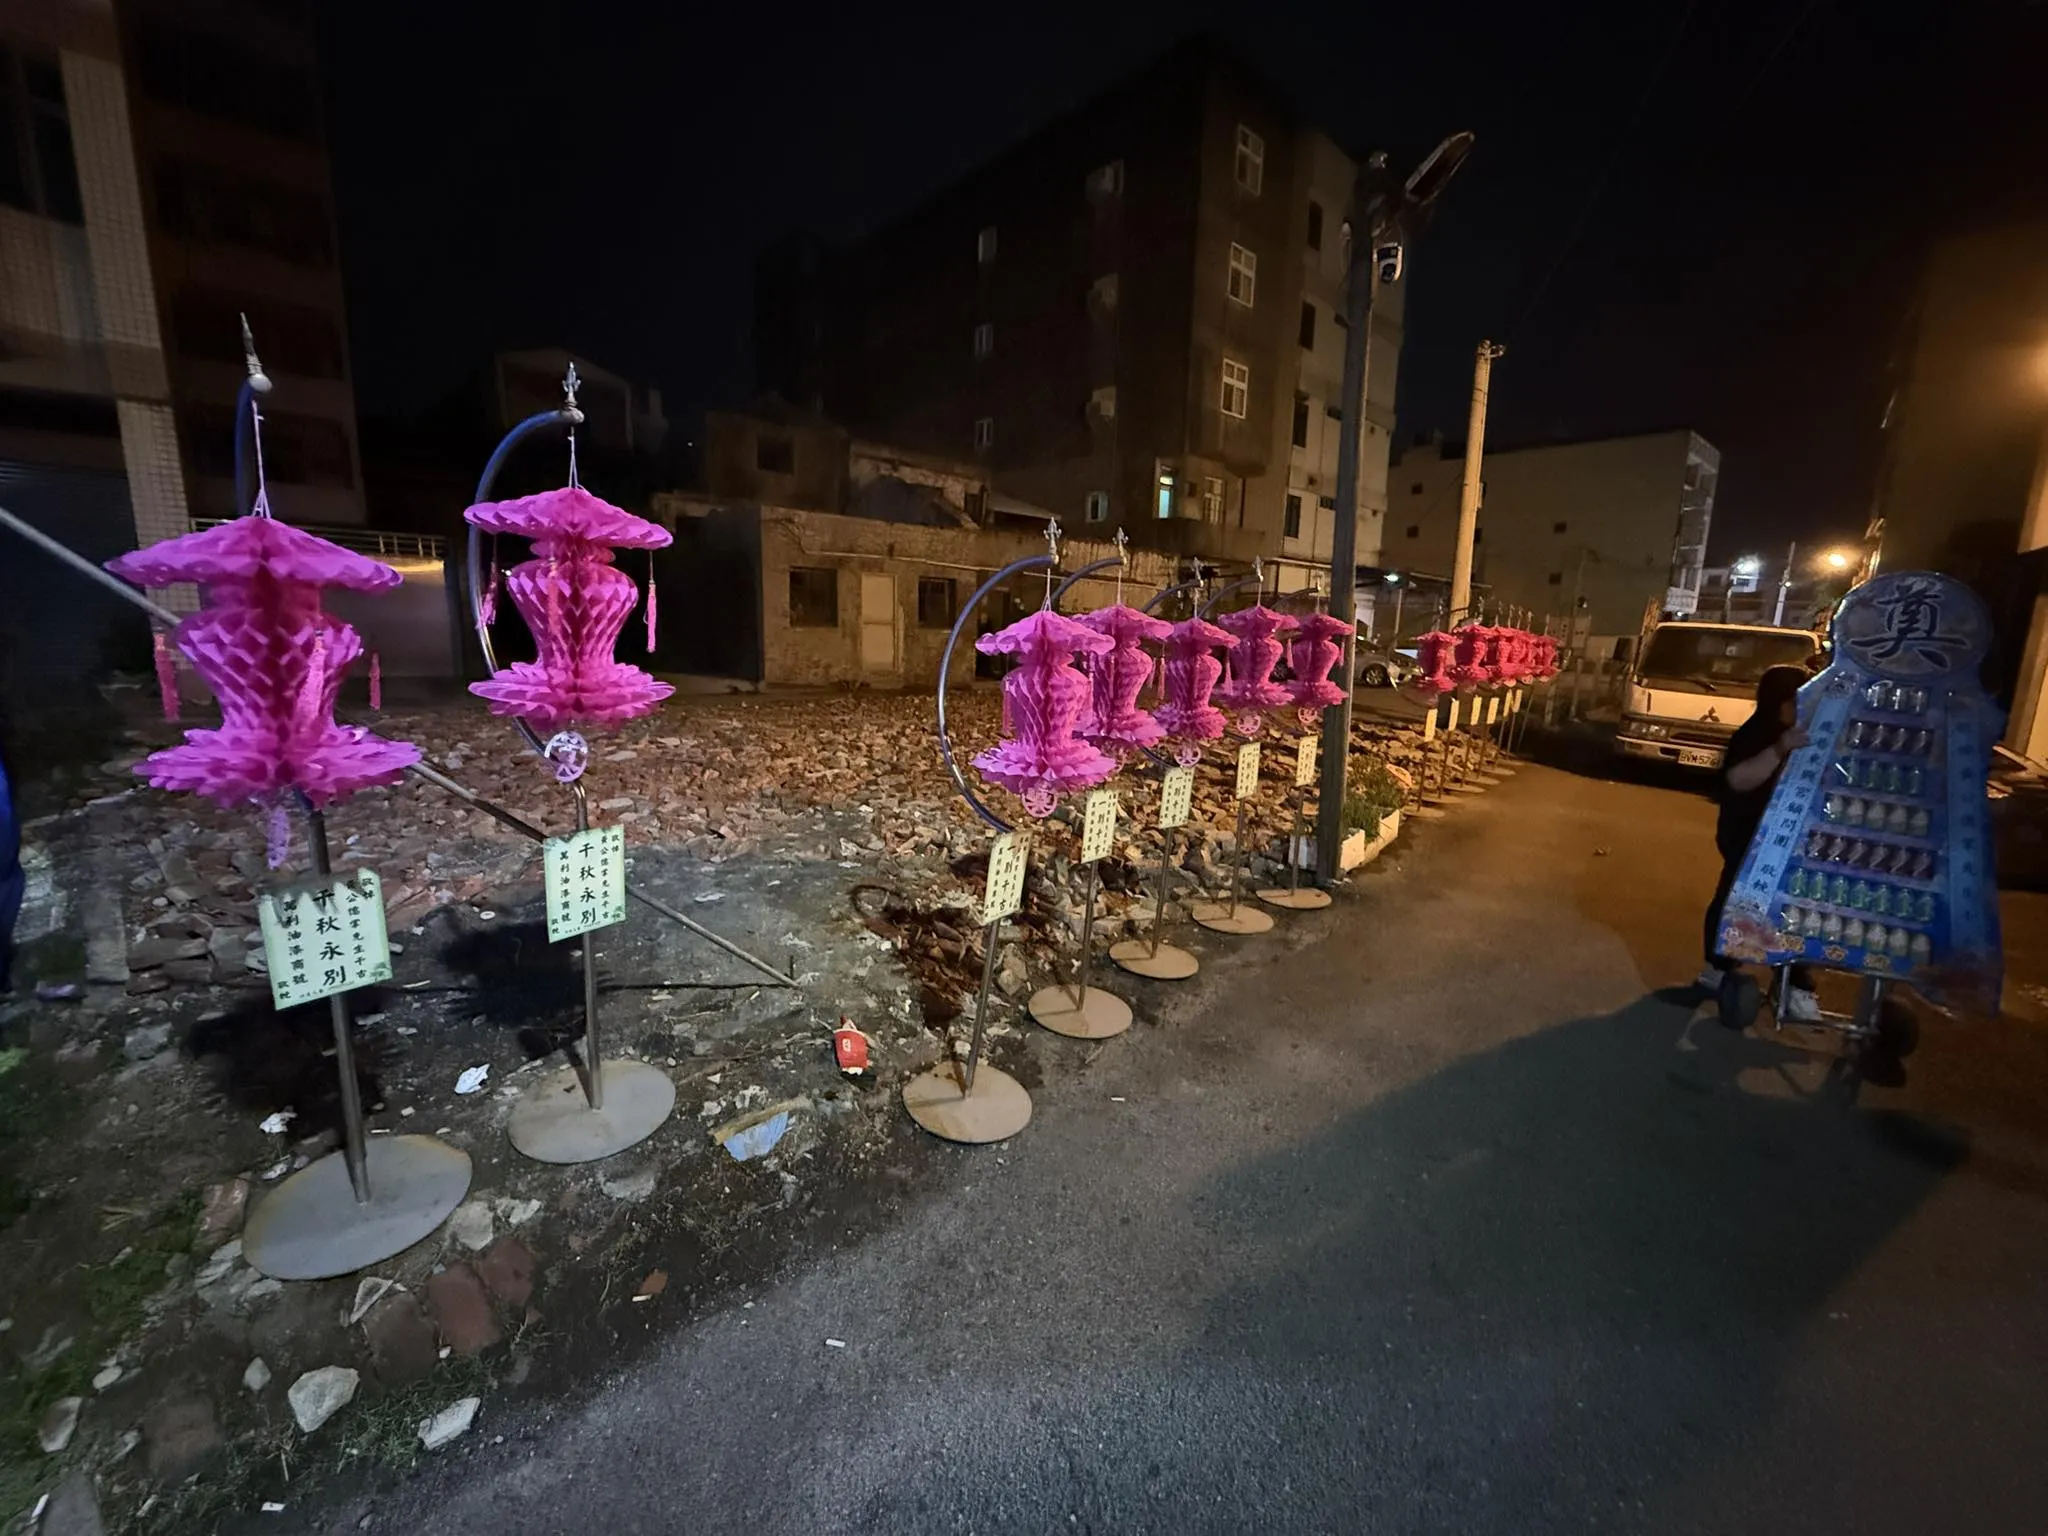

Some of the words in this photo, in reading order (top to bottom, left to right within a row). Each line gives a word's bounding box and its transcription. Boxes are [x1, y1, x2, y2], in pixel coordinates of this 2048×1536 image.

[1850, 580, 1970, 670] 奠
[578, 842, 596, 925] 千秋永別
[312, 889, 346, 987] 千秋永別
